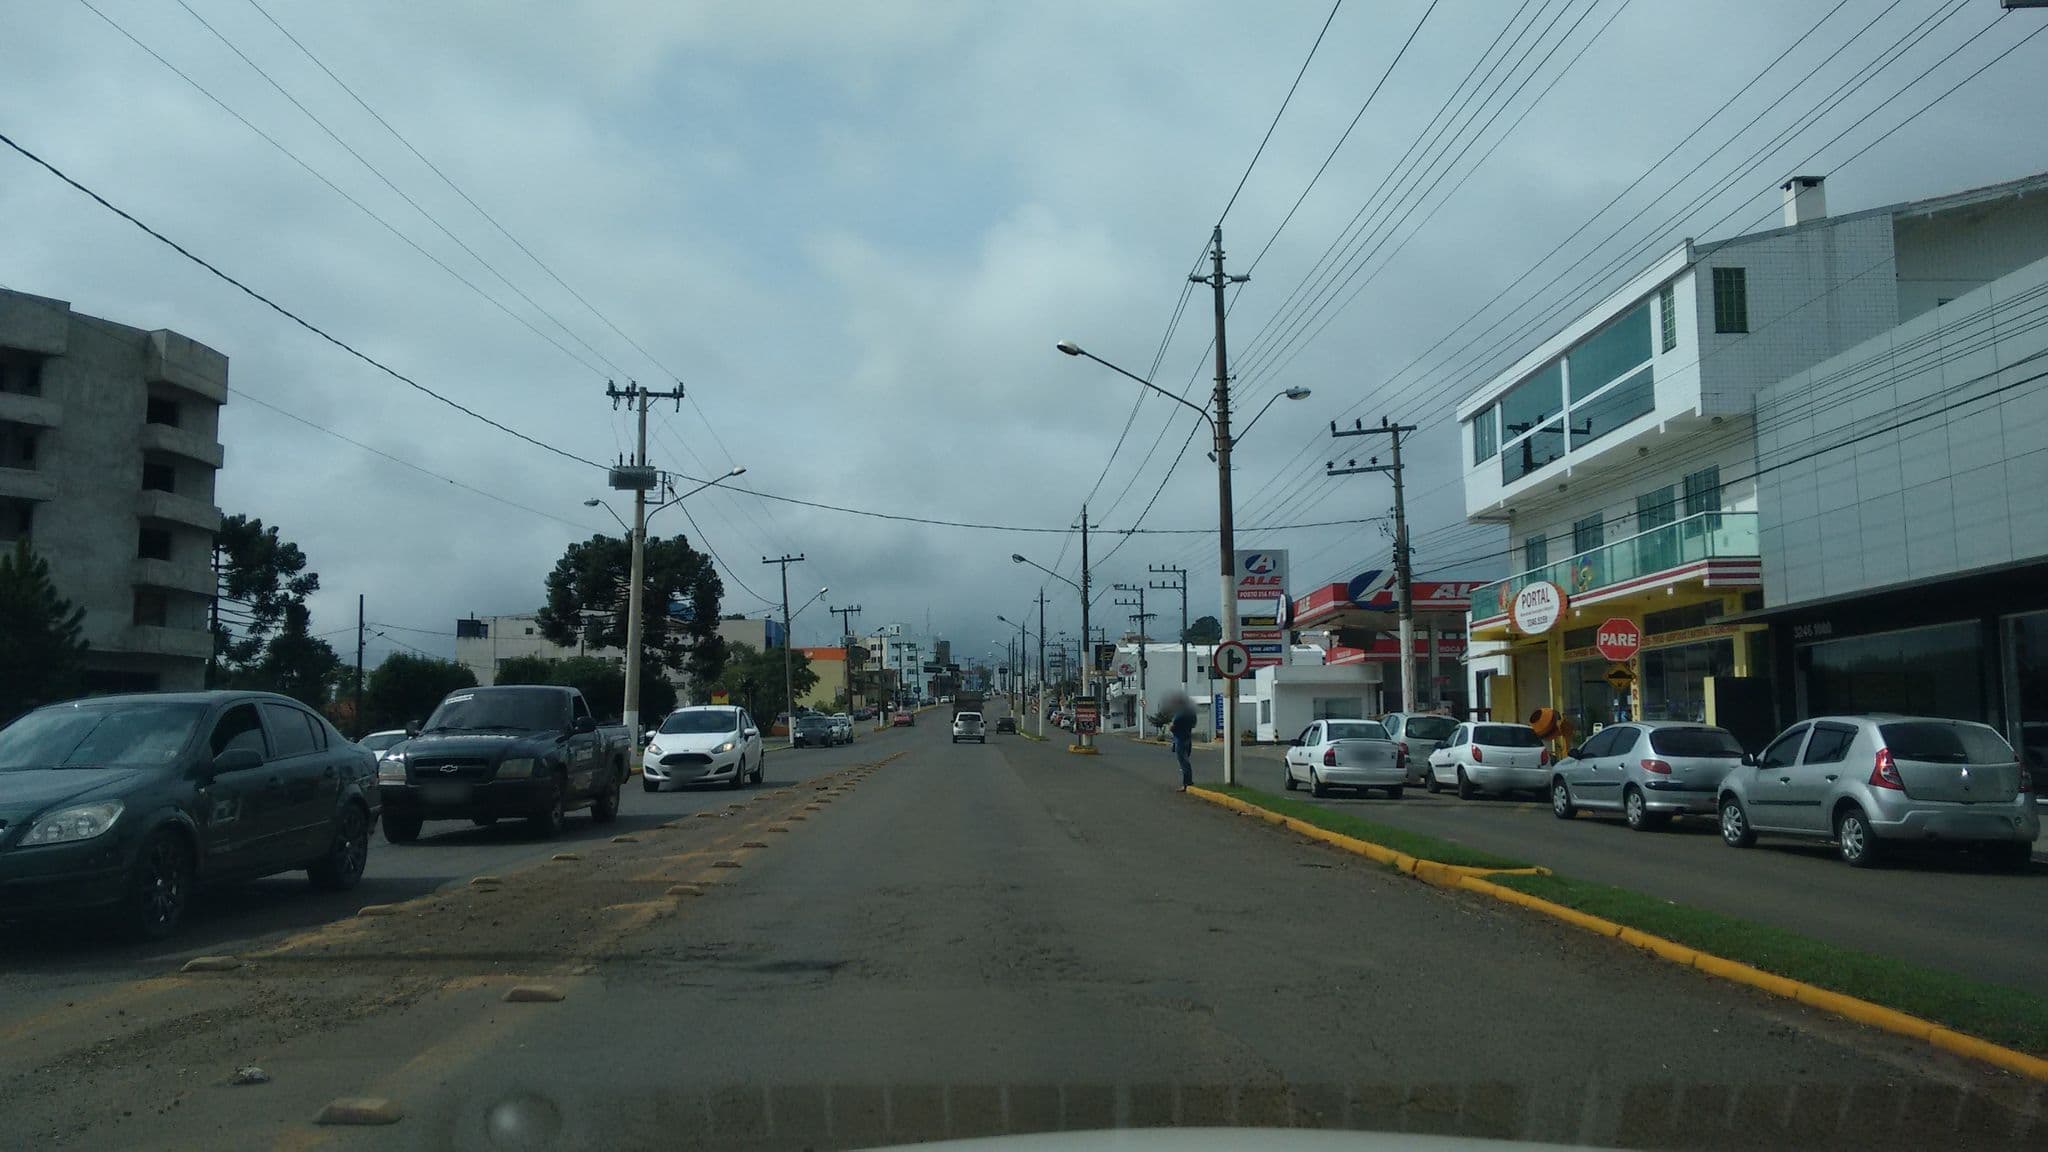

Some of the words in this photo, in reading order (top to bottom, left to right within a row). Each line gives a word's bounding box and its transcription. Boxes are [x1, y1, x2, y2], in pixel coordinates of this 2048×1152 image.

[1239, 576, 1282, 585] ALE
[1431, 583, 1487, 599] AL
[1521, 587, 1550, 609] PORTAL
[1600, 633, 1637, 647] PARE
